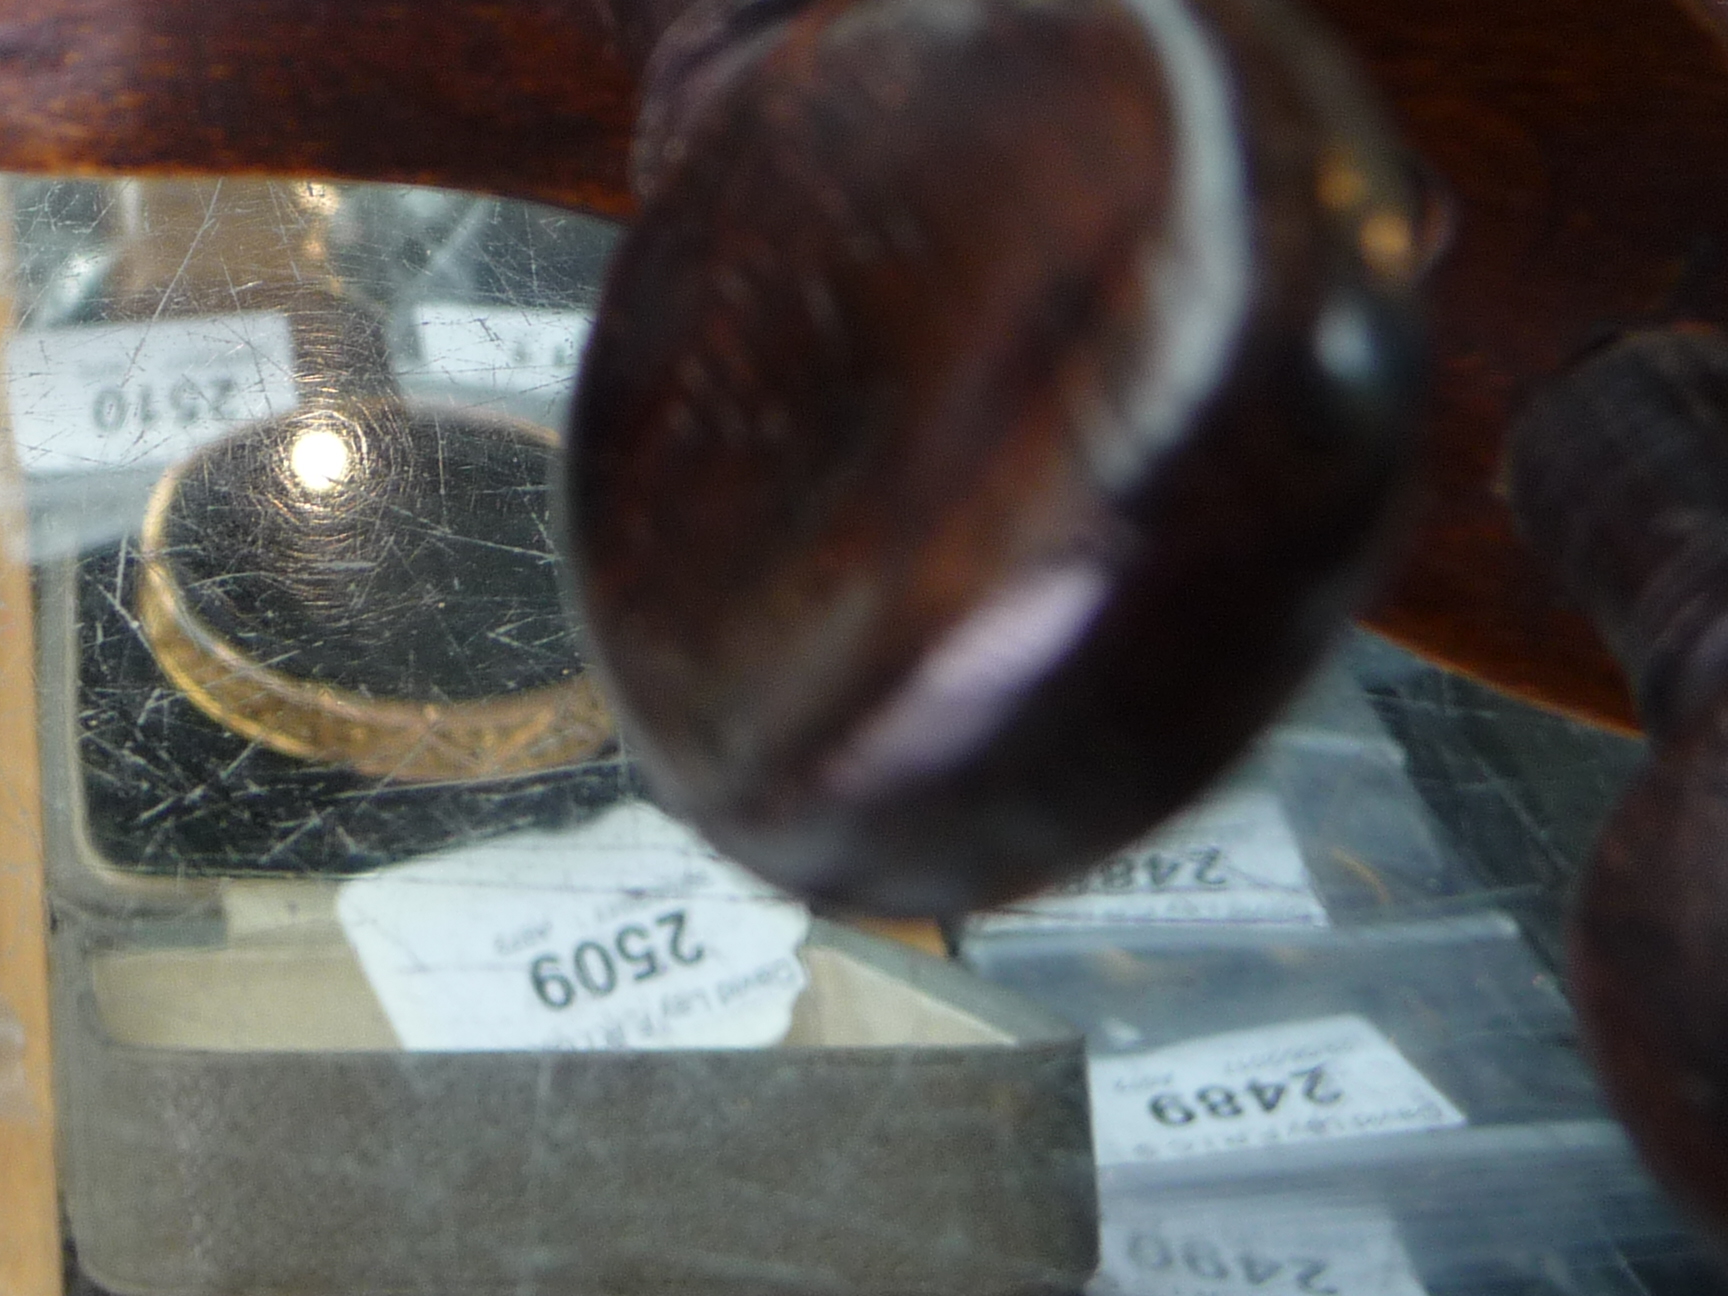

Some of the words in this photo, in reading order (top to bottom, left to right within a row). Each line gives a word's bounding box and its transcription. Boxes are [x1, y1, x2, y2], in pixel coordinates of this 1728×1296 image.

[88, 378, 236, 438] 2510
[530, 908, 706, 1014] 2509
[1146, 1065, 1344, 1130] 2489
